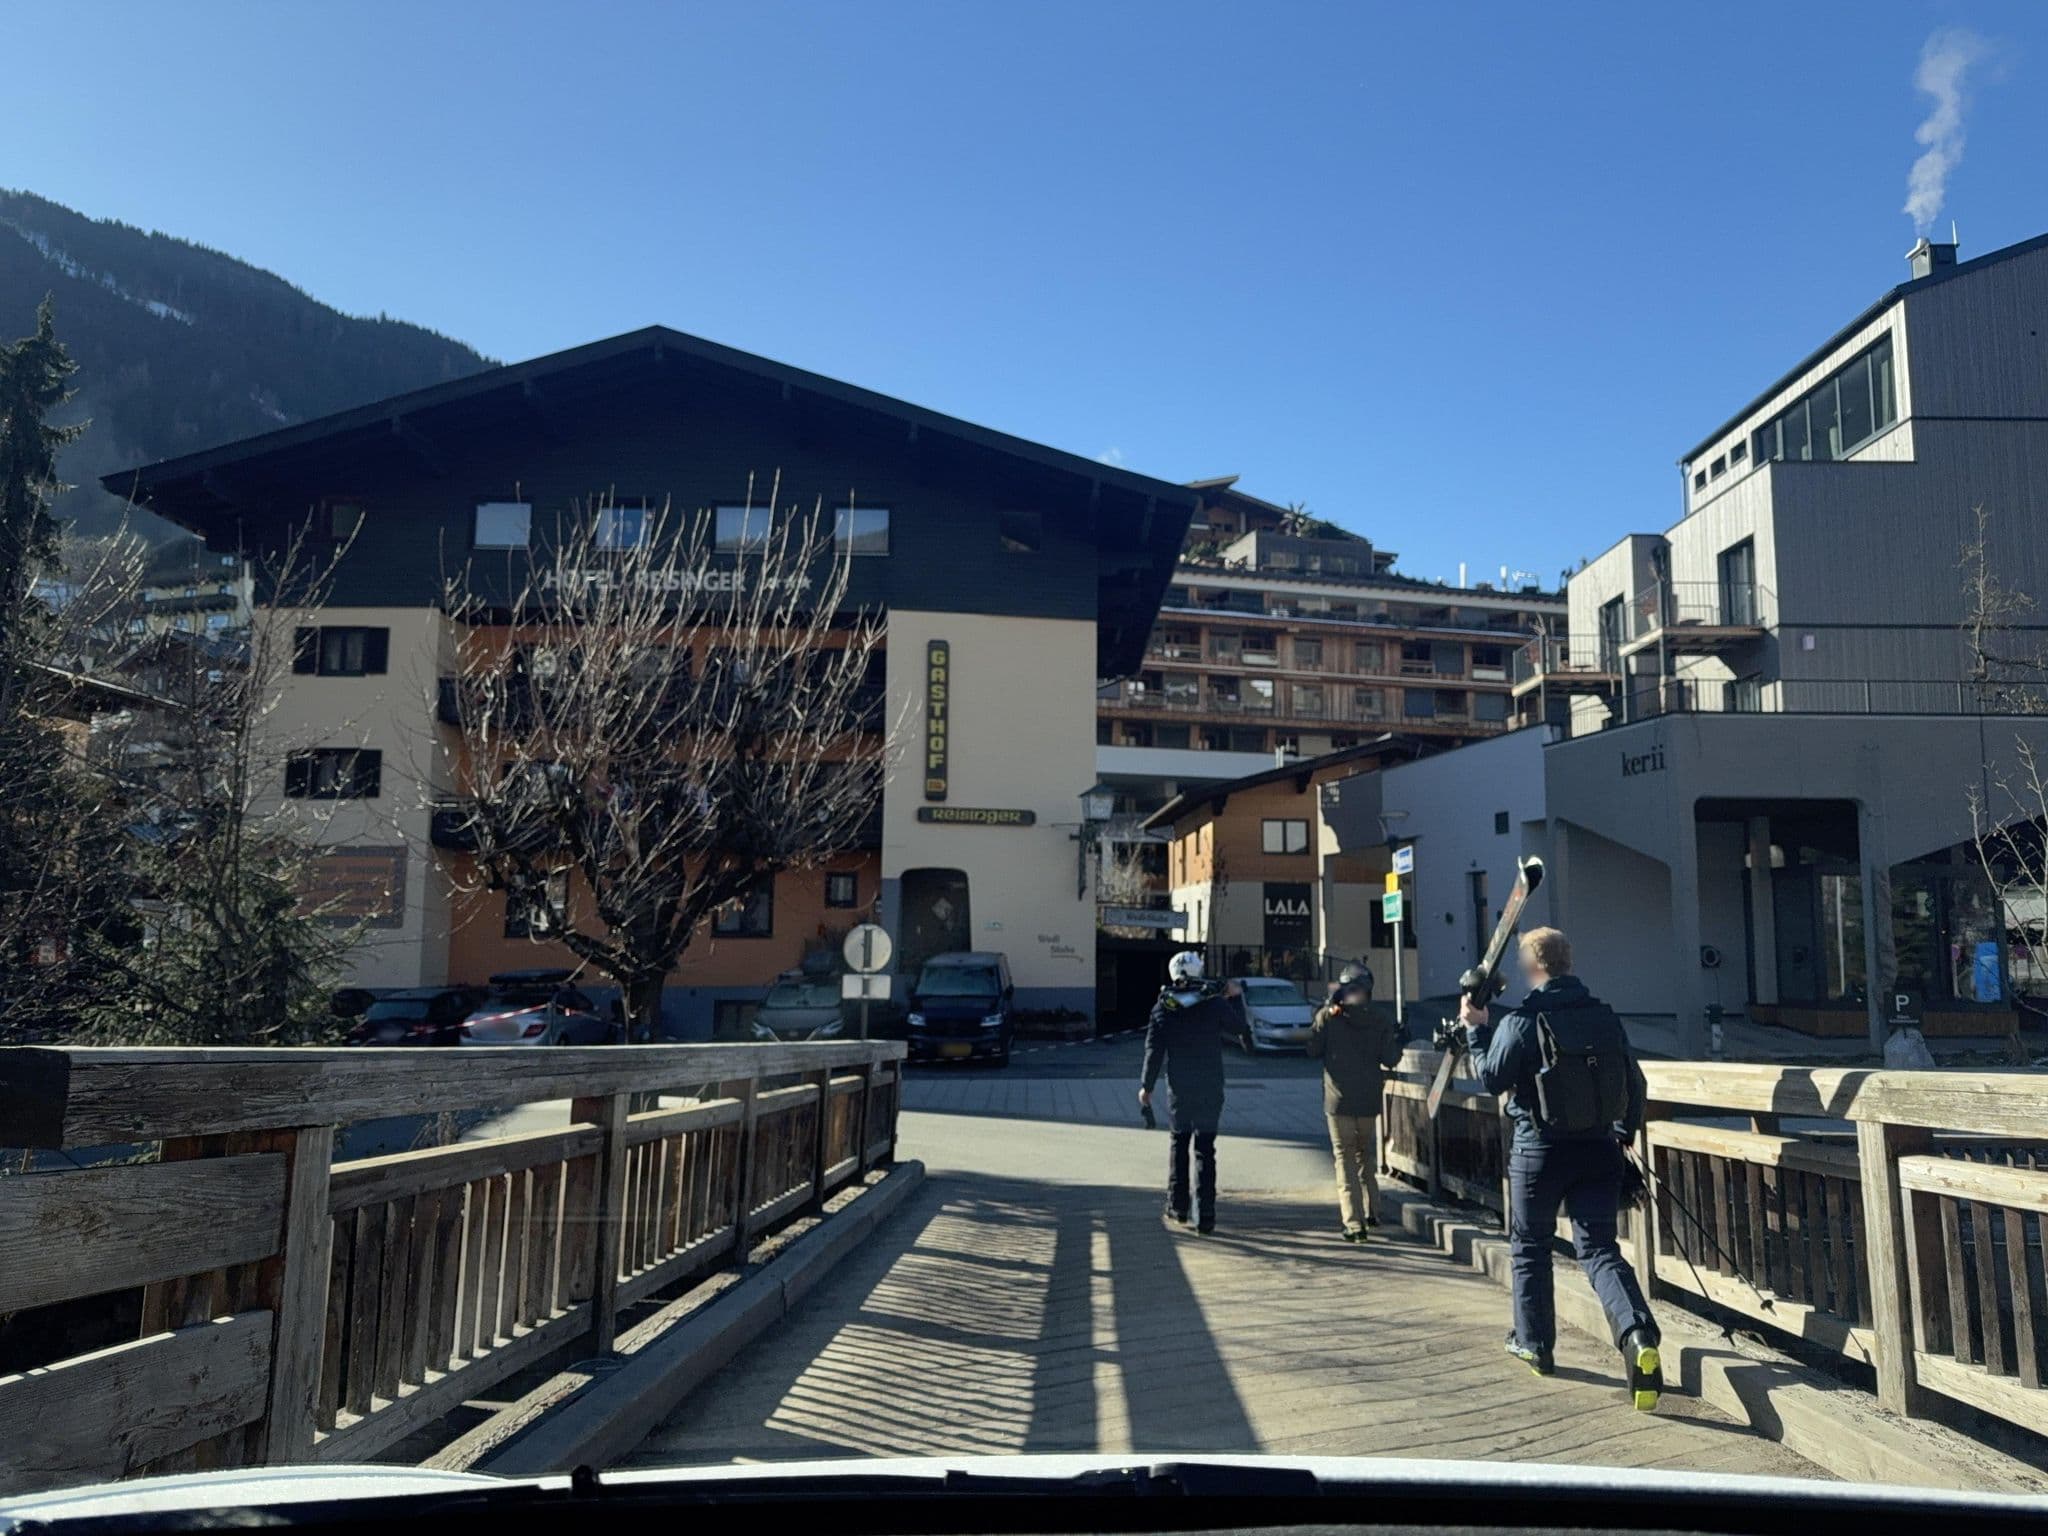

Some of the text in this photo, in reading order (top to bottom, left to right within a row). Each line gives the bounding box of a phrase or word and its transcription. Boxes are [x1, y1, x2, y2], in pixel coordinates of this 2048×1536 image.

[544, 569, 747, 592] HOTEL REISINGER
[929, 650, 946, 769] GASTHOF
[1620, 744, 1667, 776] kerii
[1265, 897, 1310, 915] LALA
[1895, 994, 1911, 1012] P
